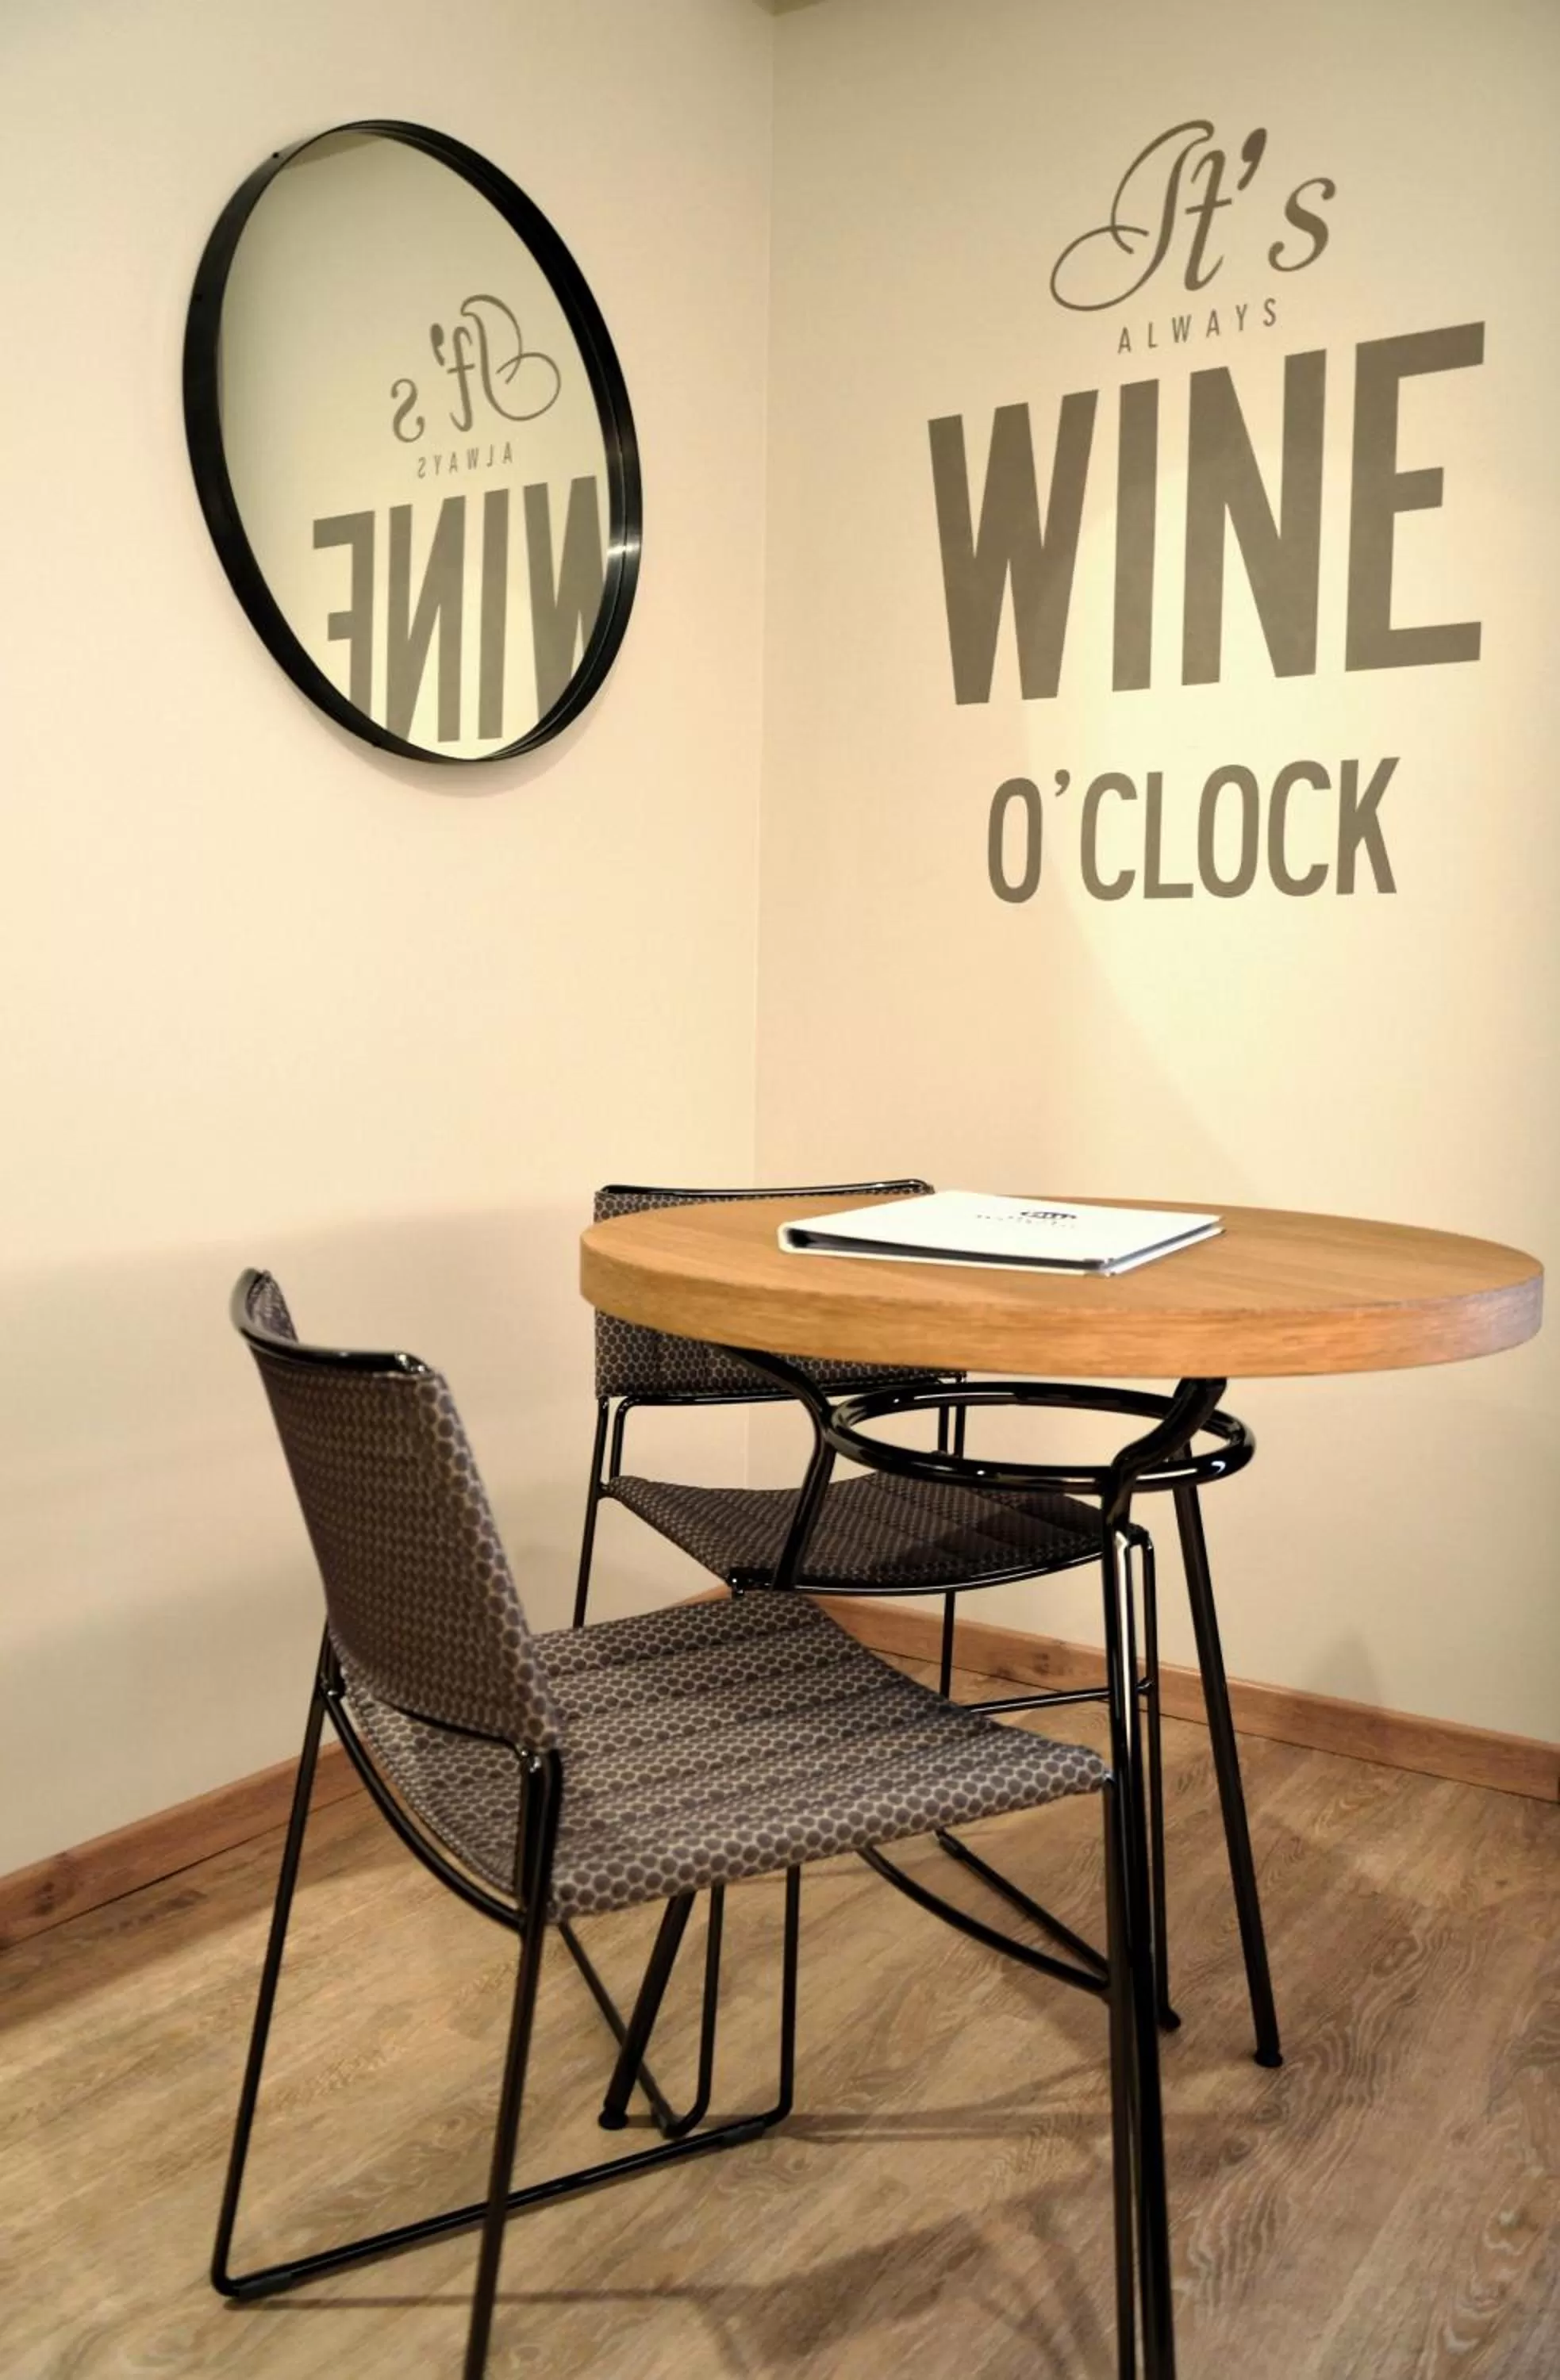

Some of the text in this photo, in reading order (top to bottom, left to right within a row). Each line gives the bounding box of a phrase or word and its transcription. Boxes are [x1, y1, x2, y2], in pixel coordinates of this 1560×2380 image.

[1050, 119, 1336, 312] It's
[1117, 298, 1278, 355] ALWAYS
[927, 321, 1485, 705] WINE
[986, 756, 1401, 904] O'CLOCK
